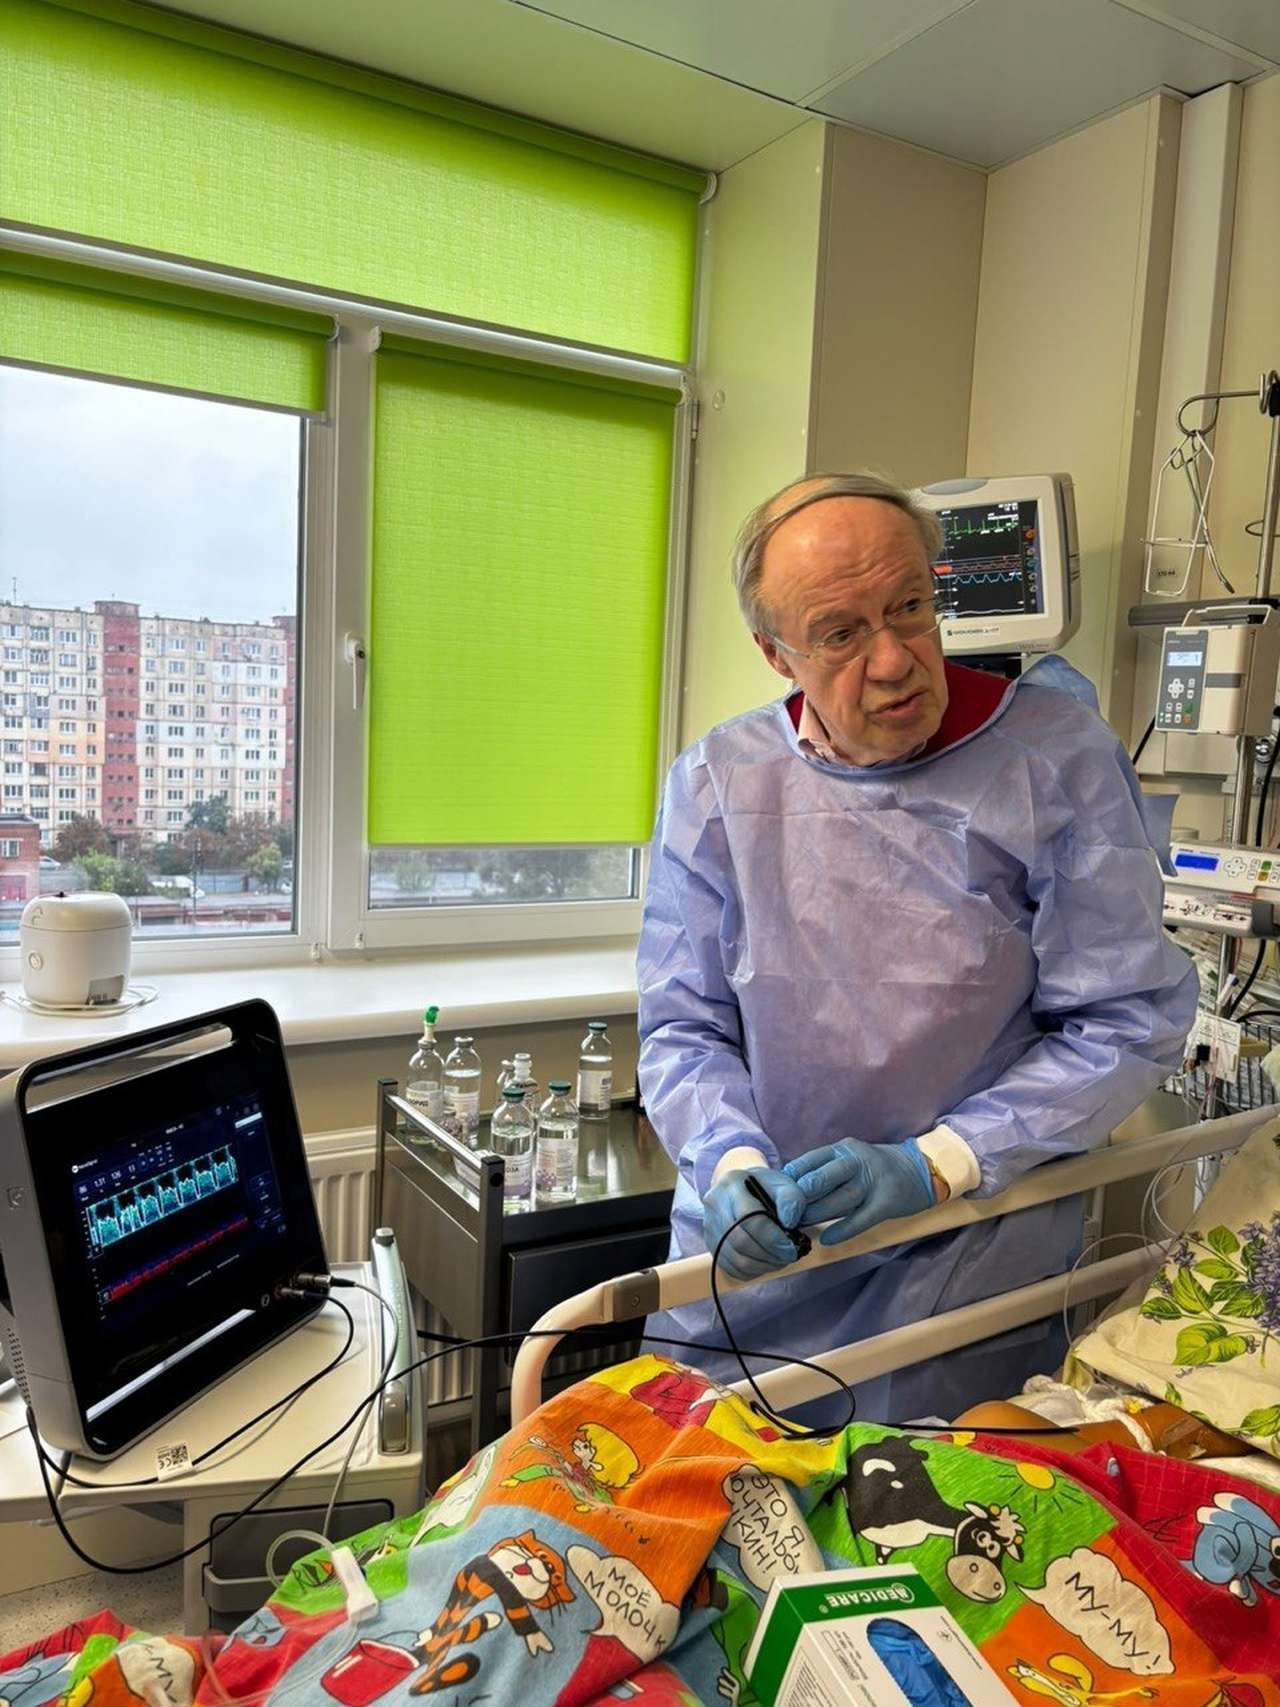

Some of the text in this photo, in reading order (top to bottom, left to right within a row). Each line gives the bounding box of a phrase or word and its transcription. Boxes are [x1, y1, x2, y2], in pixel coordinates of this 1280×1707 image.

[730, 1474, 800, 1575] ОЧТАЛЬО
[751, 1474, 788, 1518] ЭТО
[825, 1586, 909, 1608] MEDICARE
[1064, 1571, 1161, 1670] МУ-МУ!
